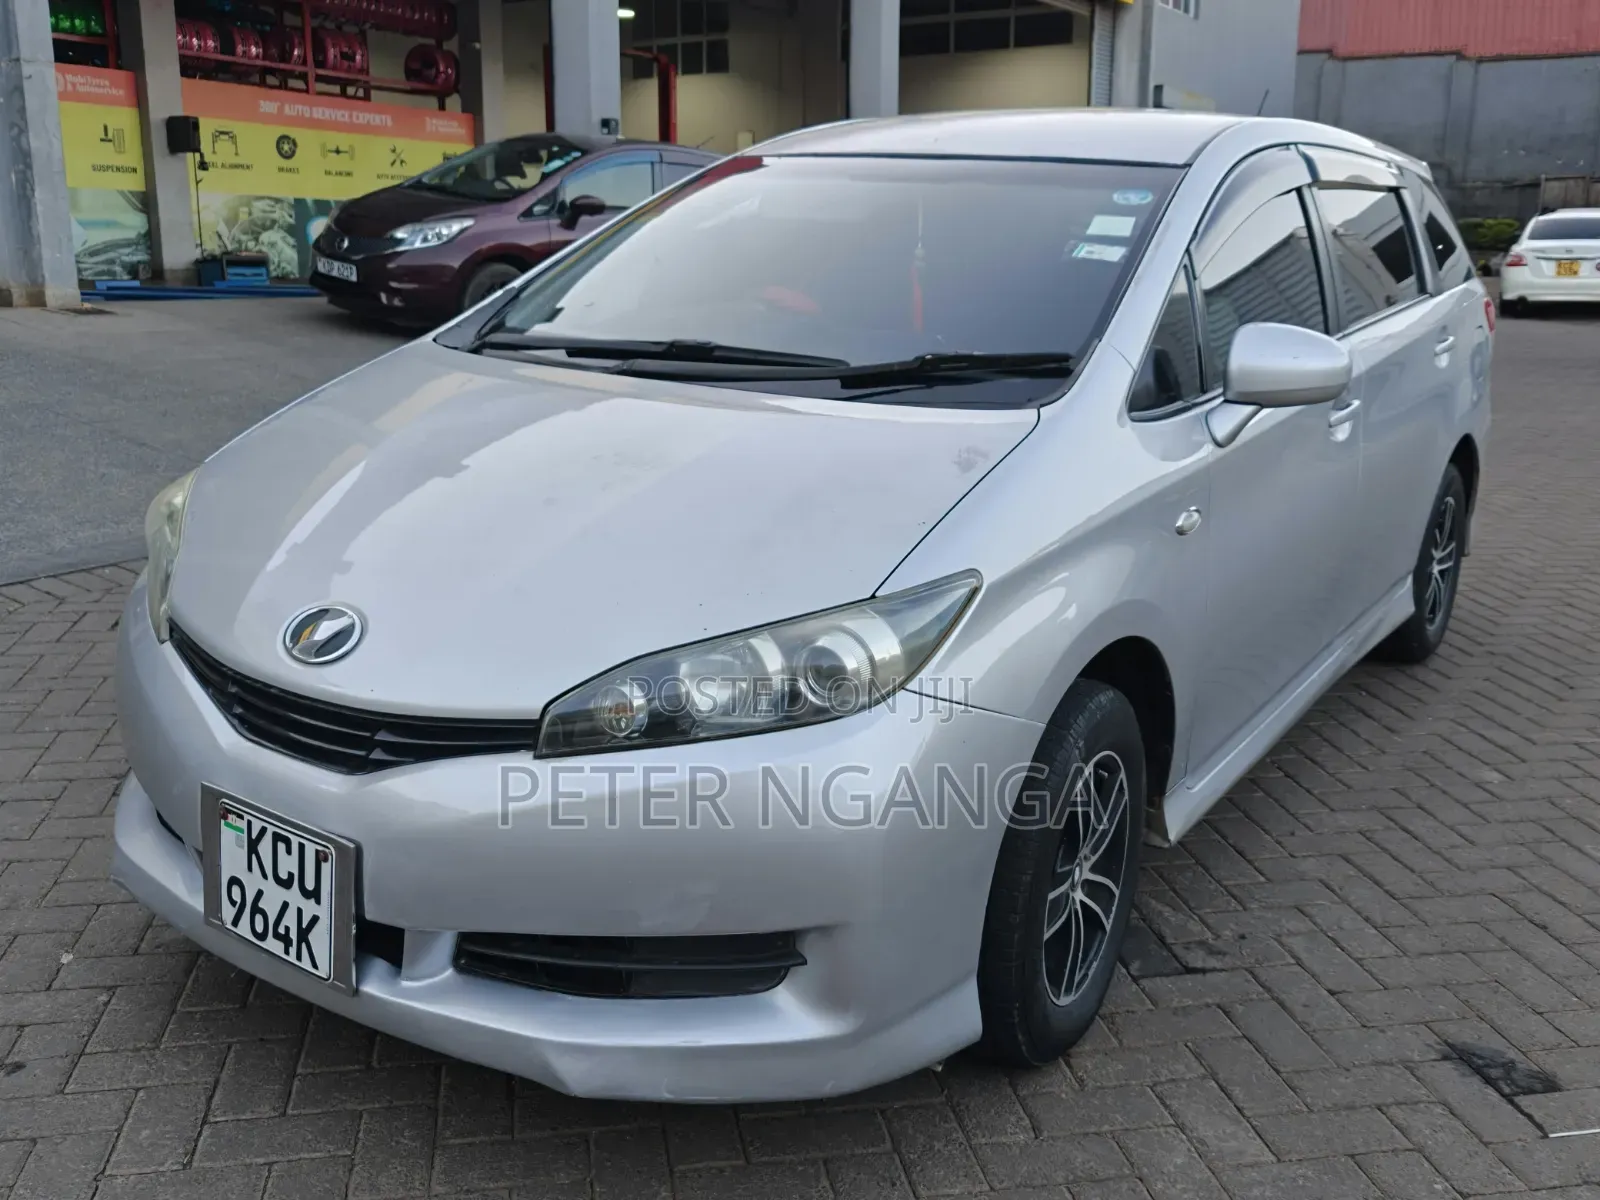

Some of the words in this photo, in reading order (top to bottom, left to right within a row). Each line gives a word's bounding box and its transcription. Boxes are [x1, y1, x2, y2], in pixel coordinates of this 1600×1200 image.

[284, 103, 311, 118] AUTO
[312, 106, 350, 122] SERVICE
[352, 110, 393, 127] EXPERTS
[91, 163, 138, 175] SUSPENSION
[220, 161, 254, 171] ALIGNMENT
[246, 819, 323, 906] KCU
[226, 875, 321, 971] 964K
